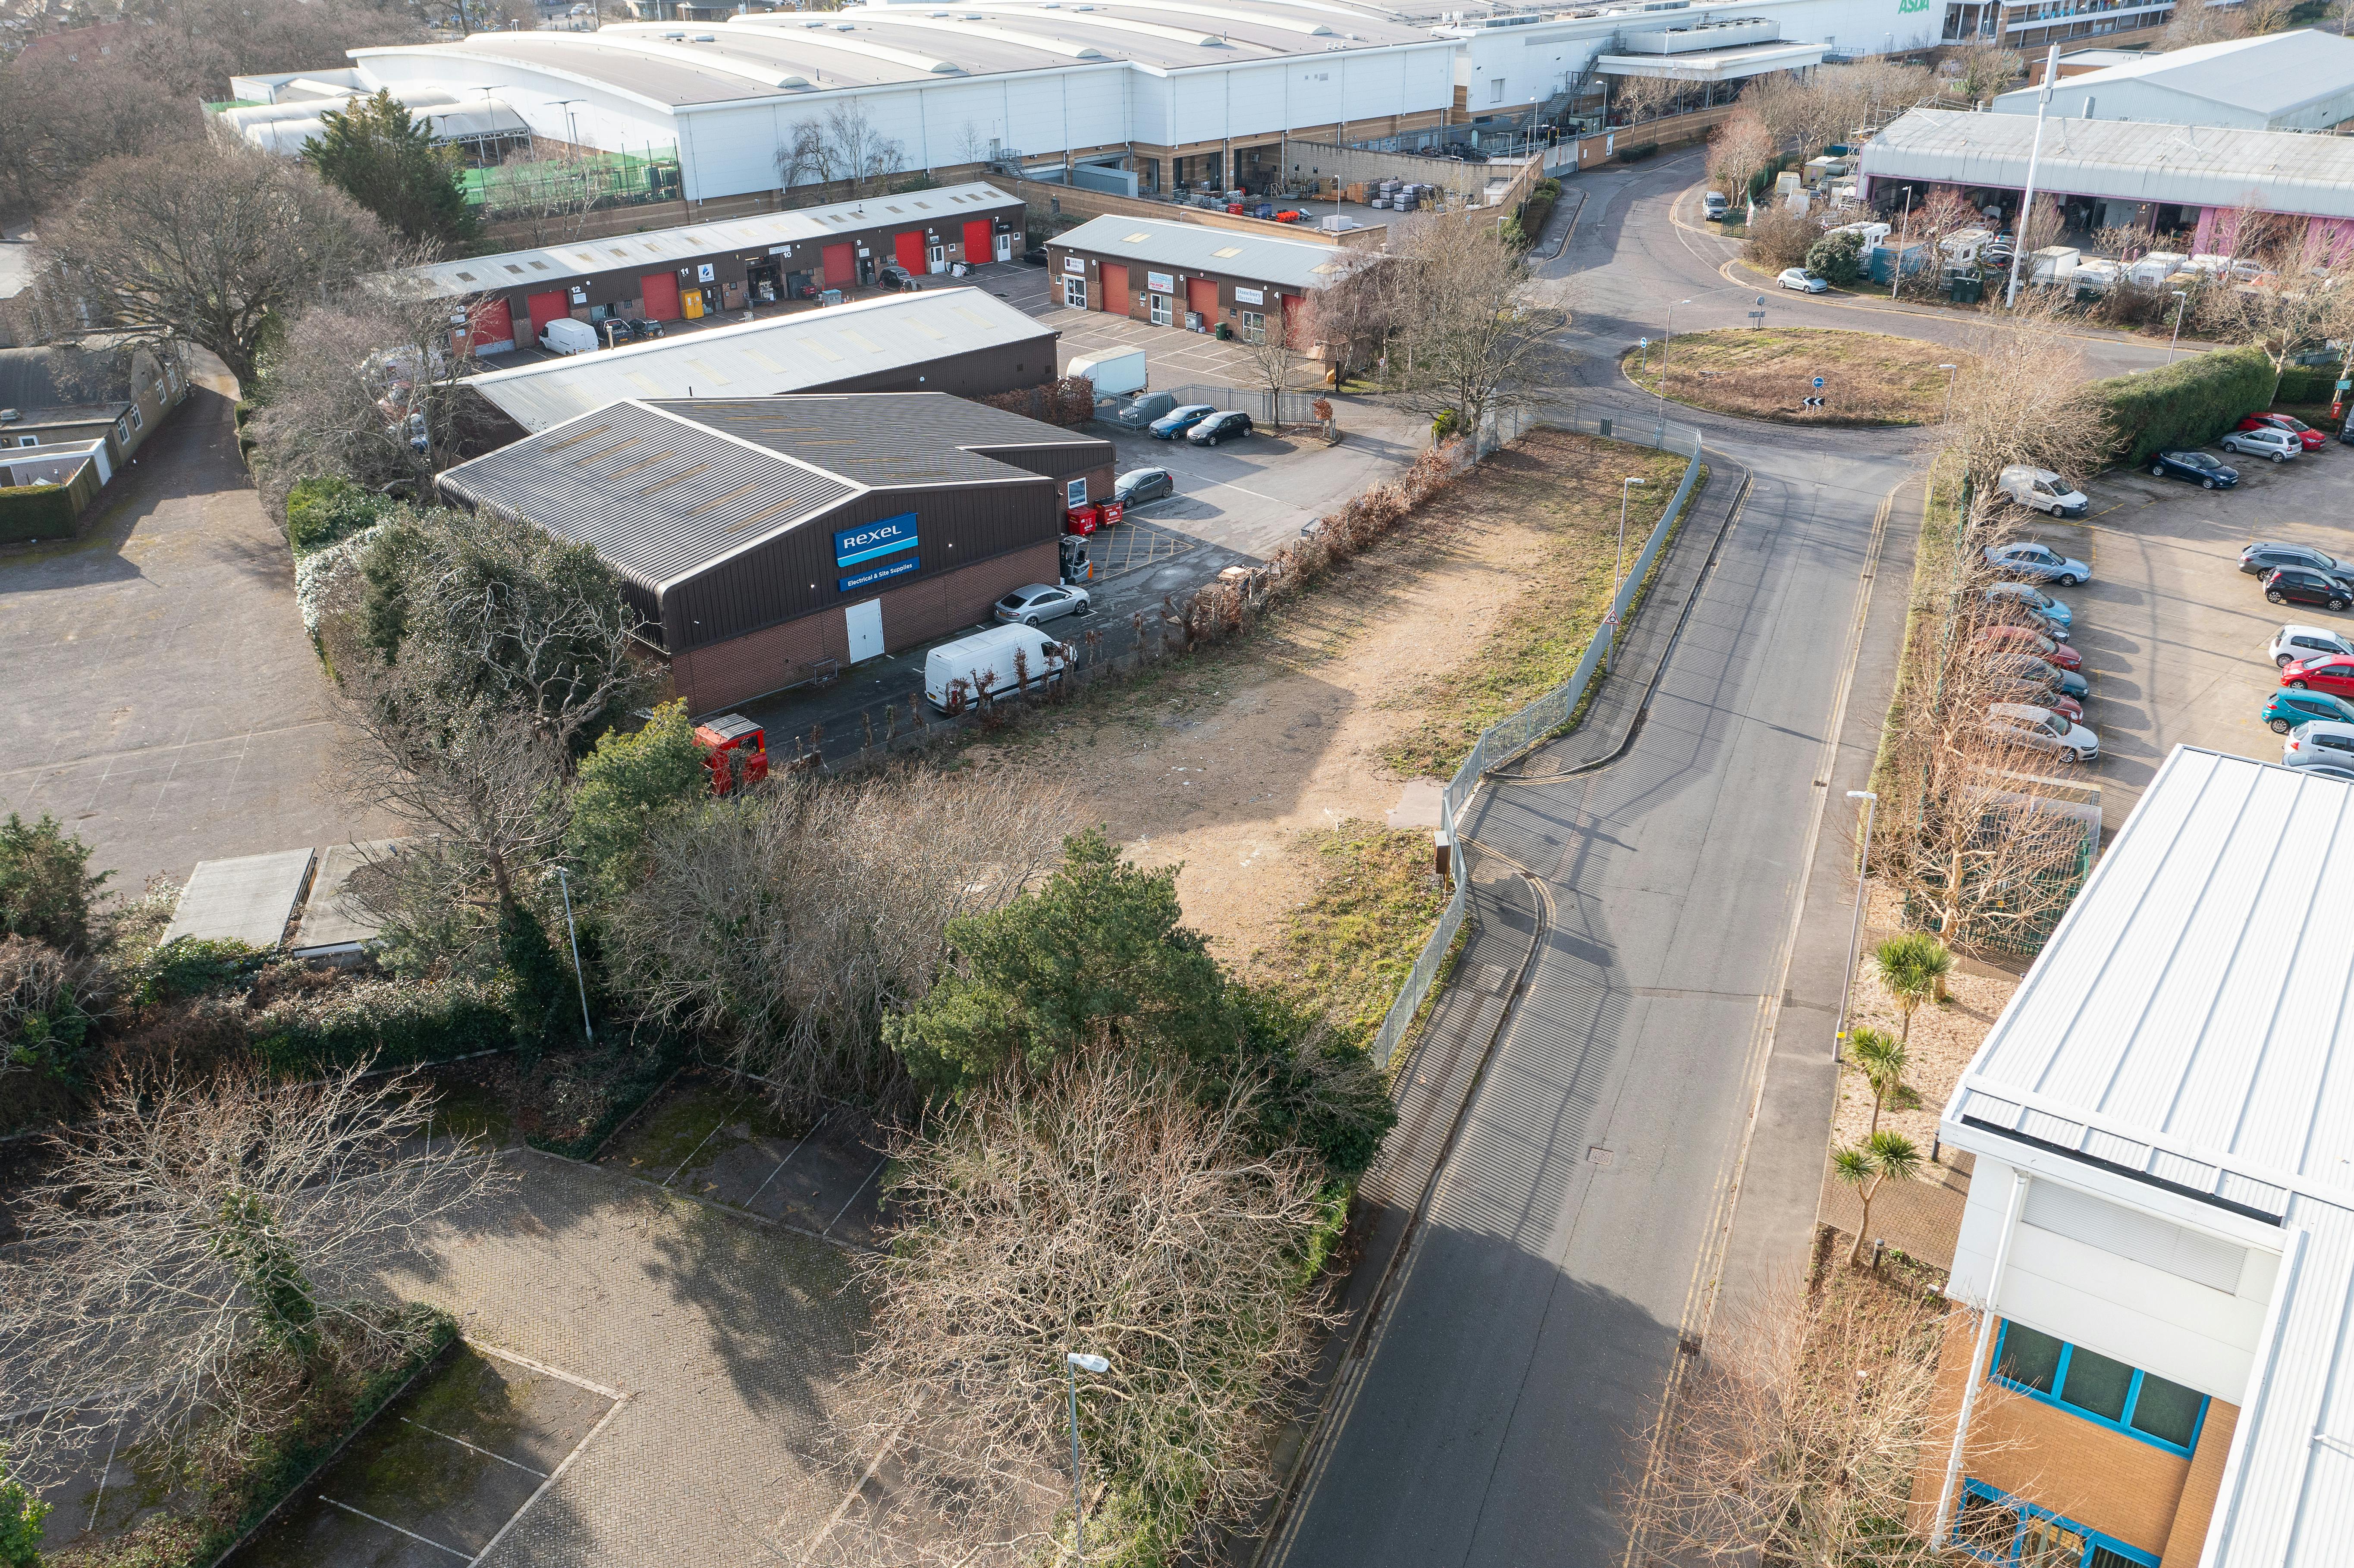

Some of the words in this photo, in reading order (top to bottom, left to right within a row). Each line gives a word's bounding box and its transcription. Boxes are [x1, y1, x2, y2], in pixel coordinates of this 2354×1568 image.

[1898, 0, 1929, 14] ASDA
[1607, 144, 1610, 154] 4
[1237, 289, 1261, 298] Danebury
[847, 574, 873, 587] Electrical
[890, 563, 913, 574] Supplies
